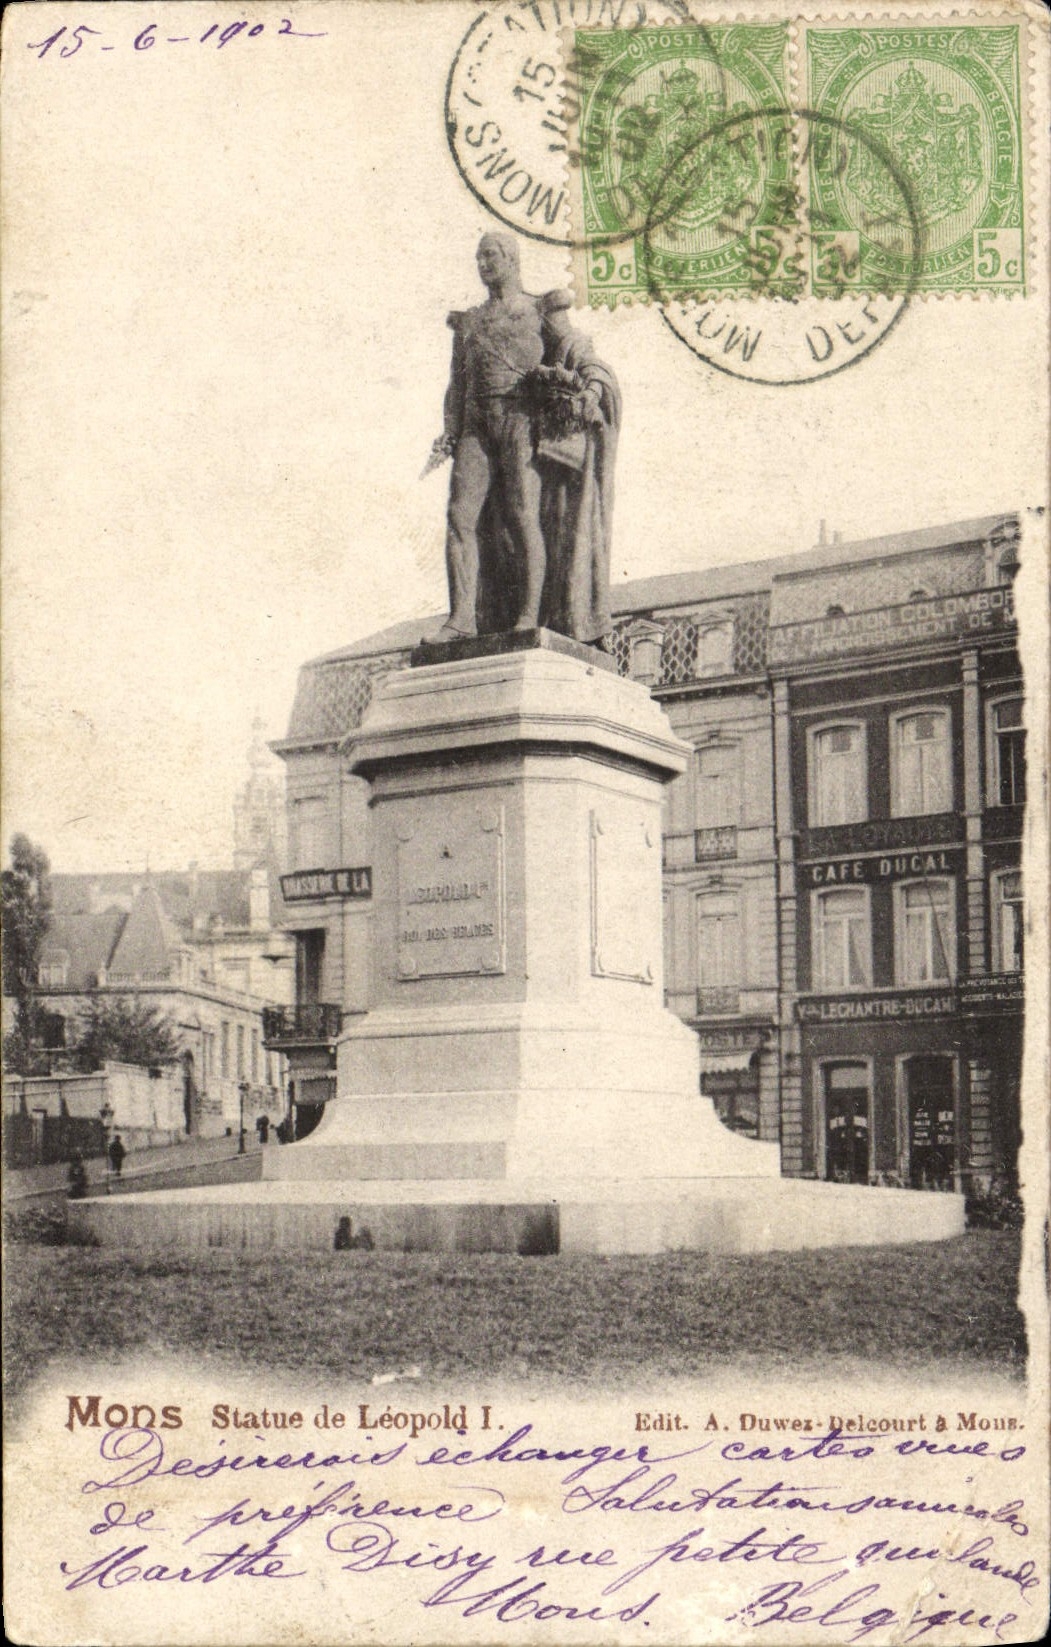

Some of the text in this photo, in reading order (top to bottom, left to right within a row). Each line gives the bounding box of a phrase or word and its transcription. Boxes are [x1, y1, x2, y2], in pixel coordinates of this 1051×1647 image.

[647, 31, 719, 49] POSTES
[876, 34, 947, 49] POSTES
[986, 91, 1012, 163] BELGIE
[879, 852, 951, 876] DUCAL
[719, 1428, 886, 1463] cartes
[89, 1501, 166, 1536] de
[58, 1543, 308, 1592] Marthe
